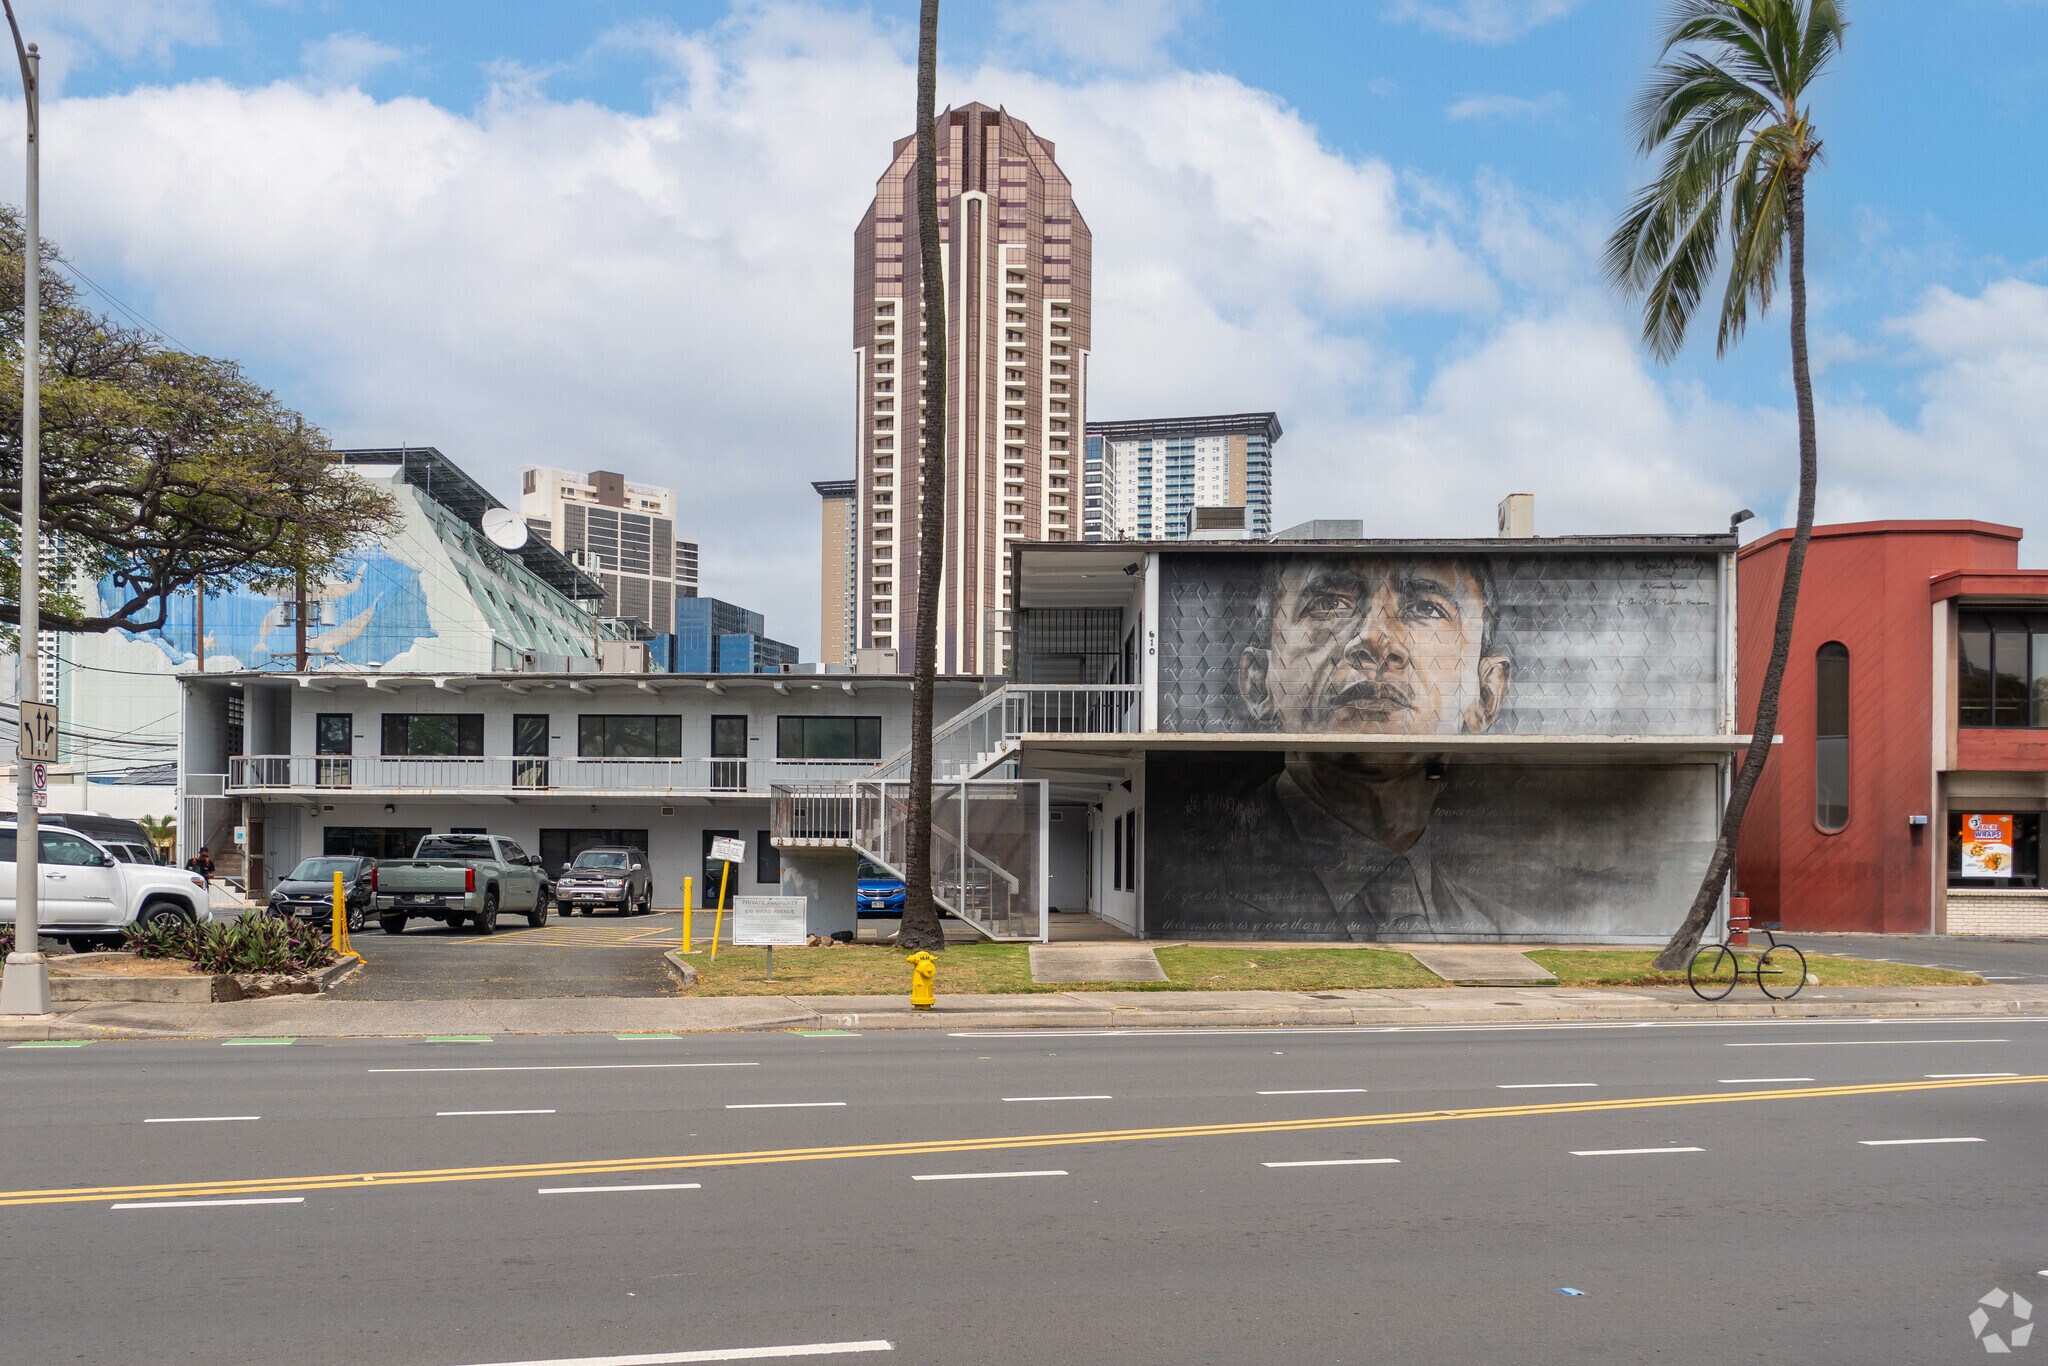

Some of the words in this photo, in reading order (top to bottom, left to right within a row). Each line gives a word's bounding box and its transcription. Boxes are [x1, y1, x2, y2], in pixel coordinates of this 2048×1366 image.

[1148, 630, 1156, 656] 610
[1974, 830, 2002, 838] WRAPS
[395, 875, 447, 883] TUNDRA
[1290, 917, 1322, 931] than
